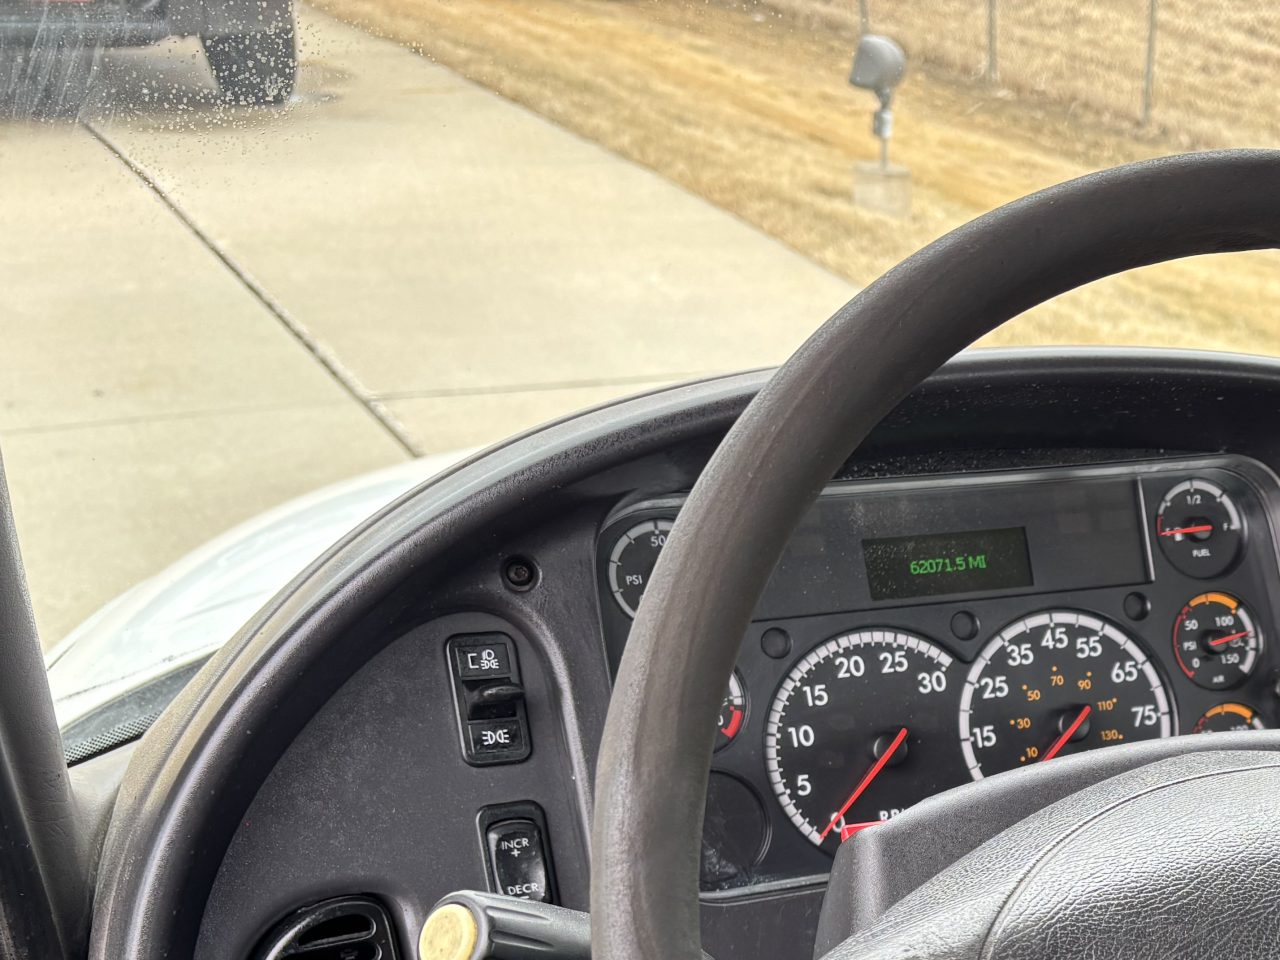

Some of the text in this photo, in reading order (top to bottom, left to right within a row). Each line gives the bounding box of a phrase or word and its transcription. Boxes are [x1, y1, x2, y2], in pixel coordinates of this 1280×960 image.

[1186, 495, 1202, 505] 1/2
[1192, 549, 1211, 557] FUEL
[910, 555, 987, 575] 62071.5 MI
[625, 574, 643, 585] PSI
[1184, 620, 1198, 631] 50
[1215, 616, 1234, 627] 100
[1041, 628, 1069, 649] 45
[1076, 636, 1103, 658] 55
[1183, 641, 1197, 651] PSI
[1006, 644, 1034, 666] 35
[1220, 653, 1240, 665] 150
[835, 655, 865, 679] 20
[880, 651, 908, 674] 25
[1192, 658, 1200, 668] 0
[1111, 661, 1139, 683] 65
[918, 671, 947, 694] 30
[1050, 675, 1064, 686] 70
[1077, 679, 1092, 690] 90
[1212, 675, 1225, 684] AIR
[980, 676, 1009, 699] 25
[803, 684, 829, 707] 15
[1027, 690, 1041, 701] 50
[1097, 700, 1114, 711] 110
[1131, 705, 1158, 727] 75
[1017, 717, 1031, 729] 30
[788, 725, 815, 748] 10
[972, 726, 997, 748] 15
[1101, 730, 1118, 741] 130
[1026, 747, 1039, 759] 10
[797, 775, 812, 796] 5
[830, 811, 846, 832] 0
[501, 838, 529, 850] INCR
[508, 883, 539, 895] DECR
